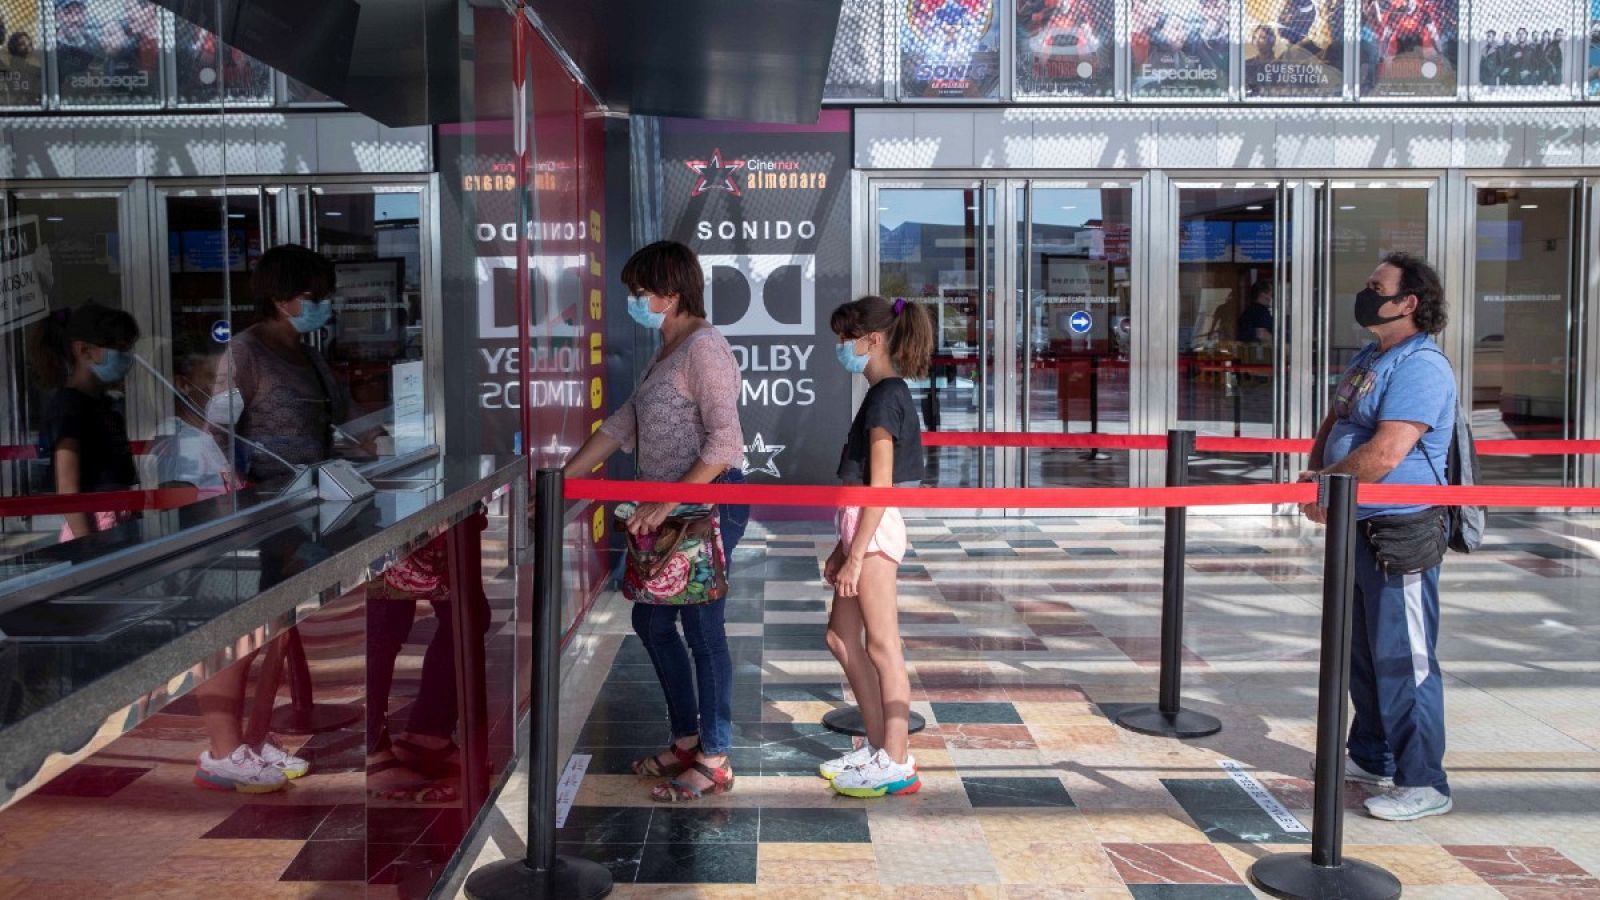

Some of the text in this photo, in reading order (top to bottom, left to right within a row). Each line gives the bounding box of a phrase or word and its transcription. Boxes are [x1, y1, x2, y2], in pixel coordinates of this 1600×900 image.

[916, 63, 988, 81] SONIC
[1142, 63, 1217, 84] Especiales
[1264, 63, 1323, 74] CUESTIÓN
[1256, 73, 1329, 84] DE JUSTICIA
[747, 159, 800, 171] Cinemax
[747, 170, 827, 189] almenara
[697, 220, 816, 241] SONIDO
[731, 344, 815, 372] OLBY
[741, 378, 816, 406] MOS
